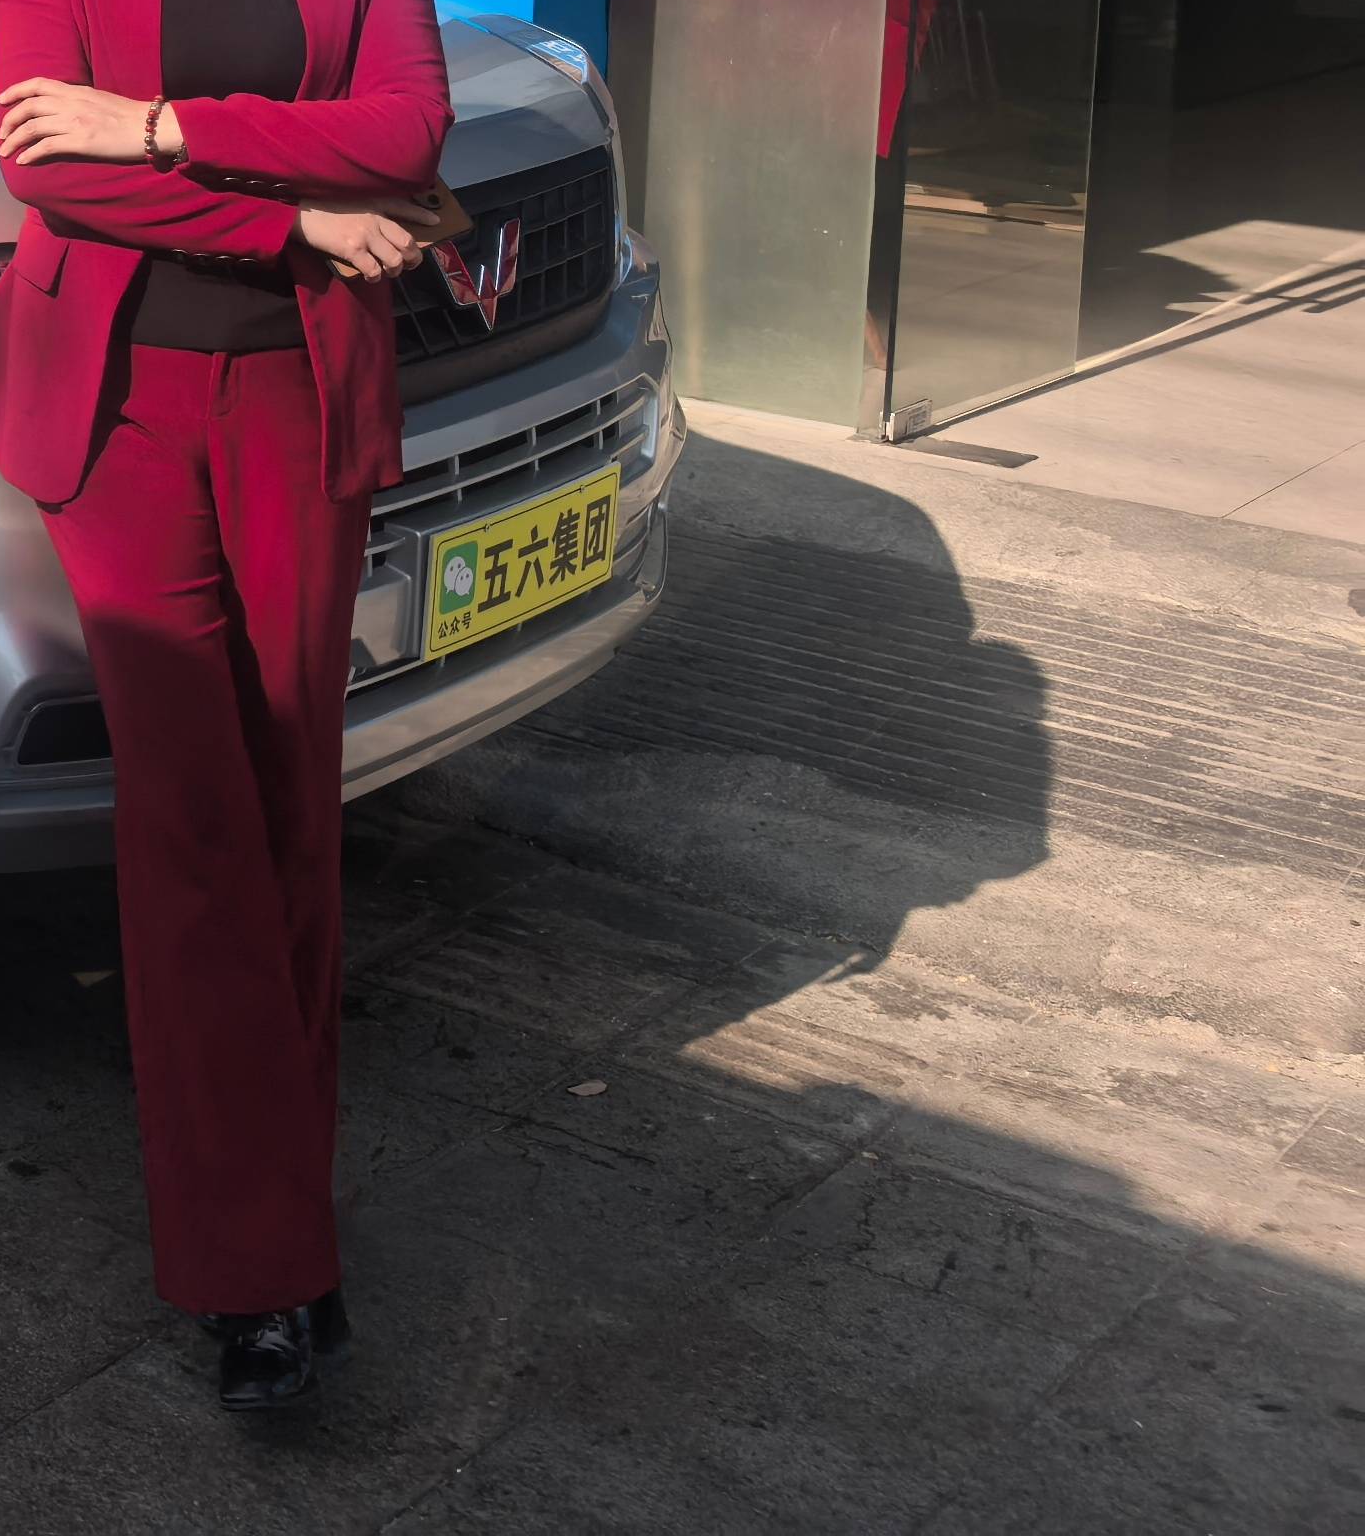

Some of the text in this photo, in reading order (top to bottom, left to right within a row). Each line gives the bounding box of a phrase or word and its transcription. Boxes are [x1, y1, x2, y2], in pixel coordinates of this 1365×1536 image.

[477, 494, 612, 614] 五六集团
[437, 611, 472, 640] 公众号
